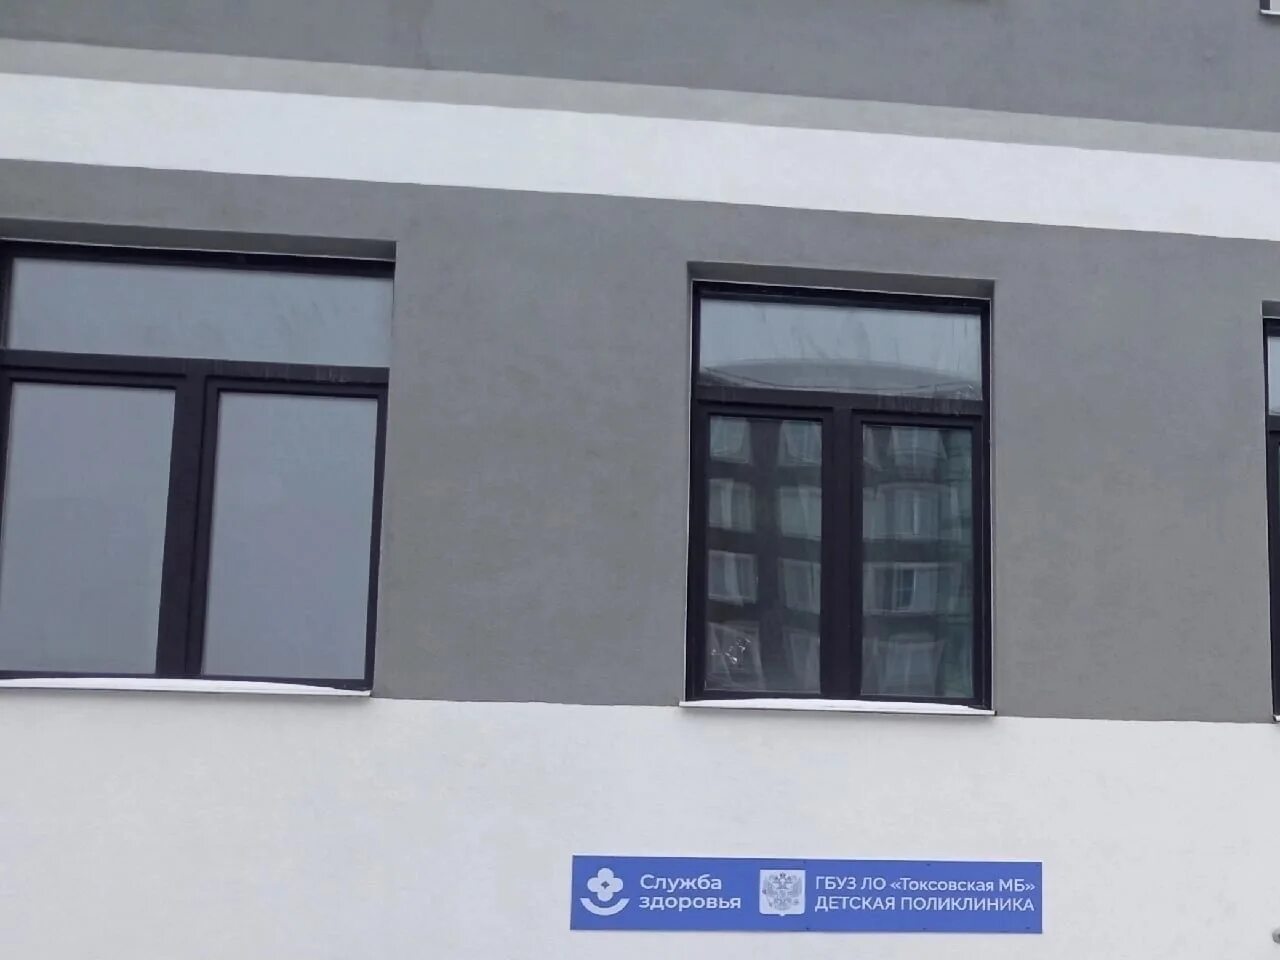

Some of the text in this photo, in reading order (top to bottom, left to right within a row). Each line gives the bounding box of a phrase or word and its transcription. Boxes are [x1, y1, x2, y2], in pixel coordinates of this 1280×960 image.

[639, 873, 722, 893] Служба
[815, 876, 1036, 892] ГБУЗ ЛО «Токсовская МБ»
[638, 896, 742, 912] здоровья
[814, 895, 1035, 912] ДЕТСКАЯ ПОЛИКЛИНИКА
